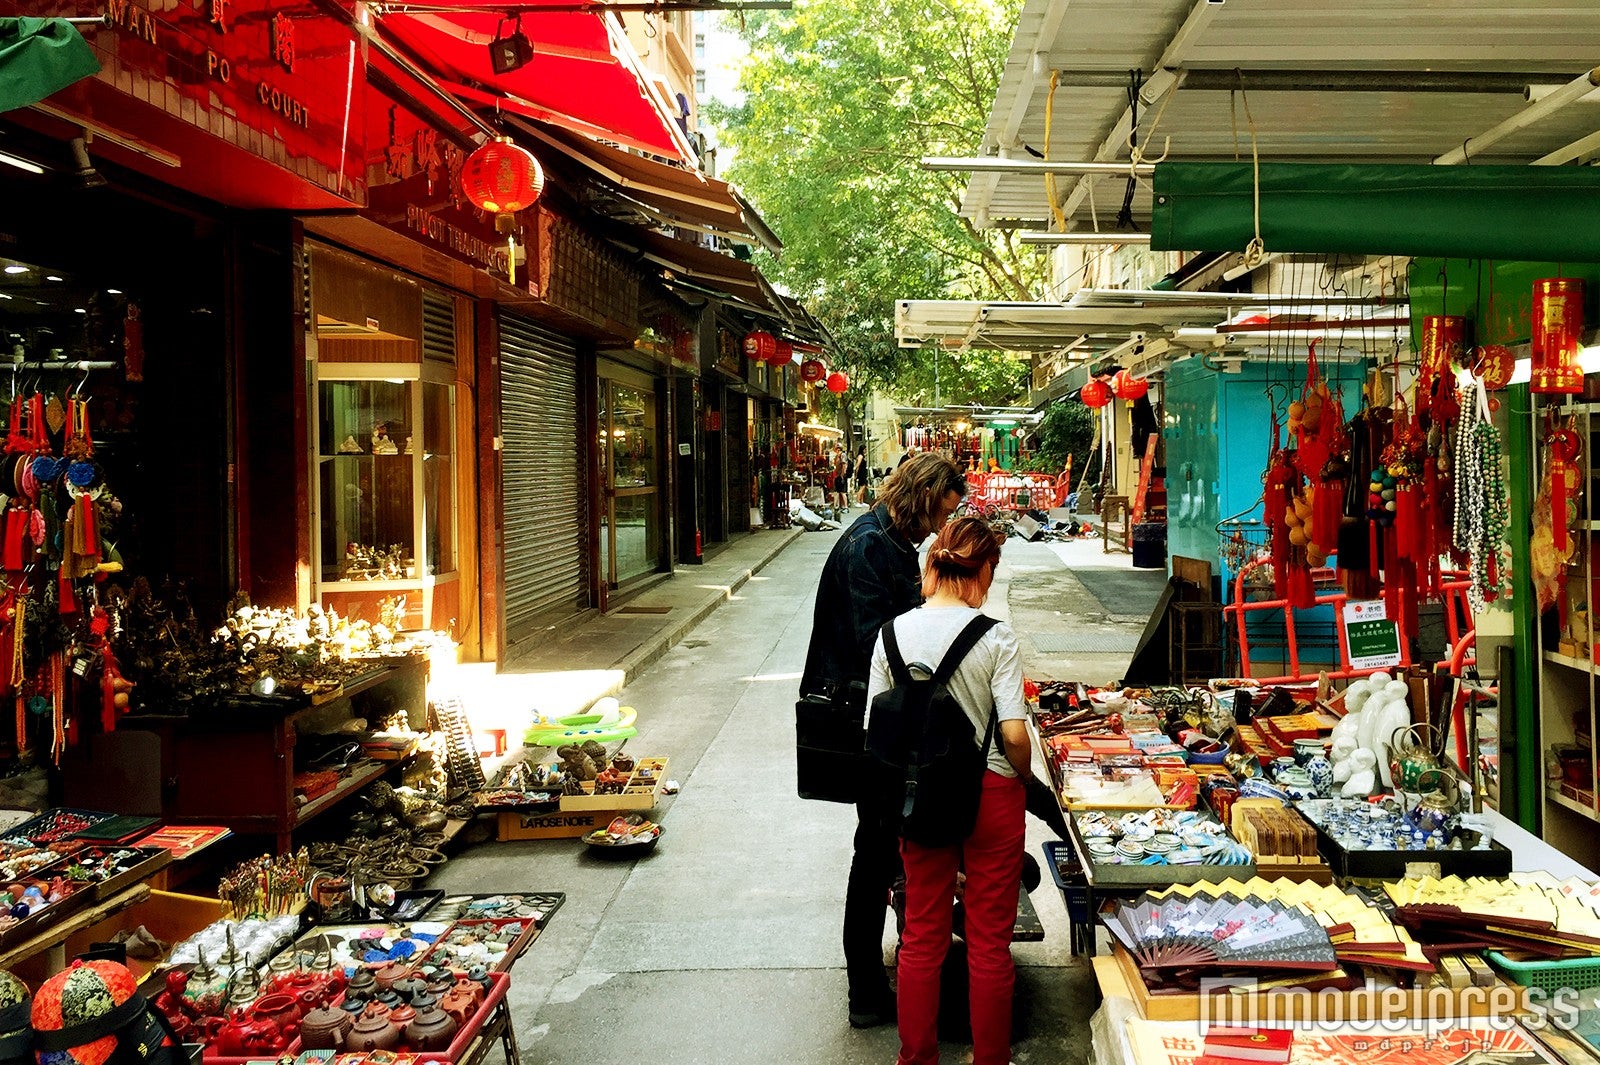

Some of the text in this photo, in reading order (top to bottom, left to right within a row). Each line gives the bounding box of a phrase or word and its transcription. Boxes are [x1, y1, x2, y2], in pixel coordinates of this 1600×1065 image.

[109, 0, 310, 129] MAN PO COURT
[406, 204, 447, 243] PIVOT
[534, 816, 563, 829] ROSE
[563, 816, 594, 827] NOIRE
